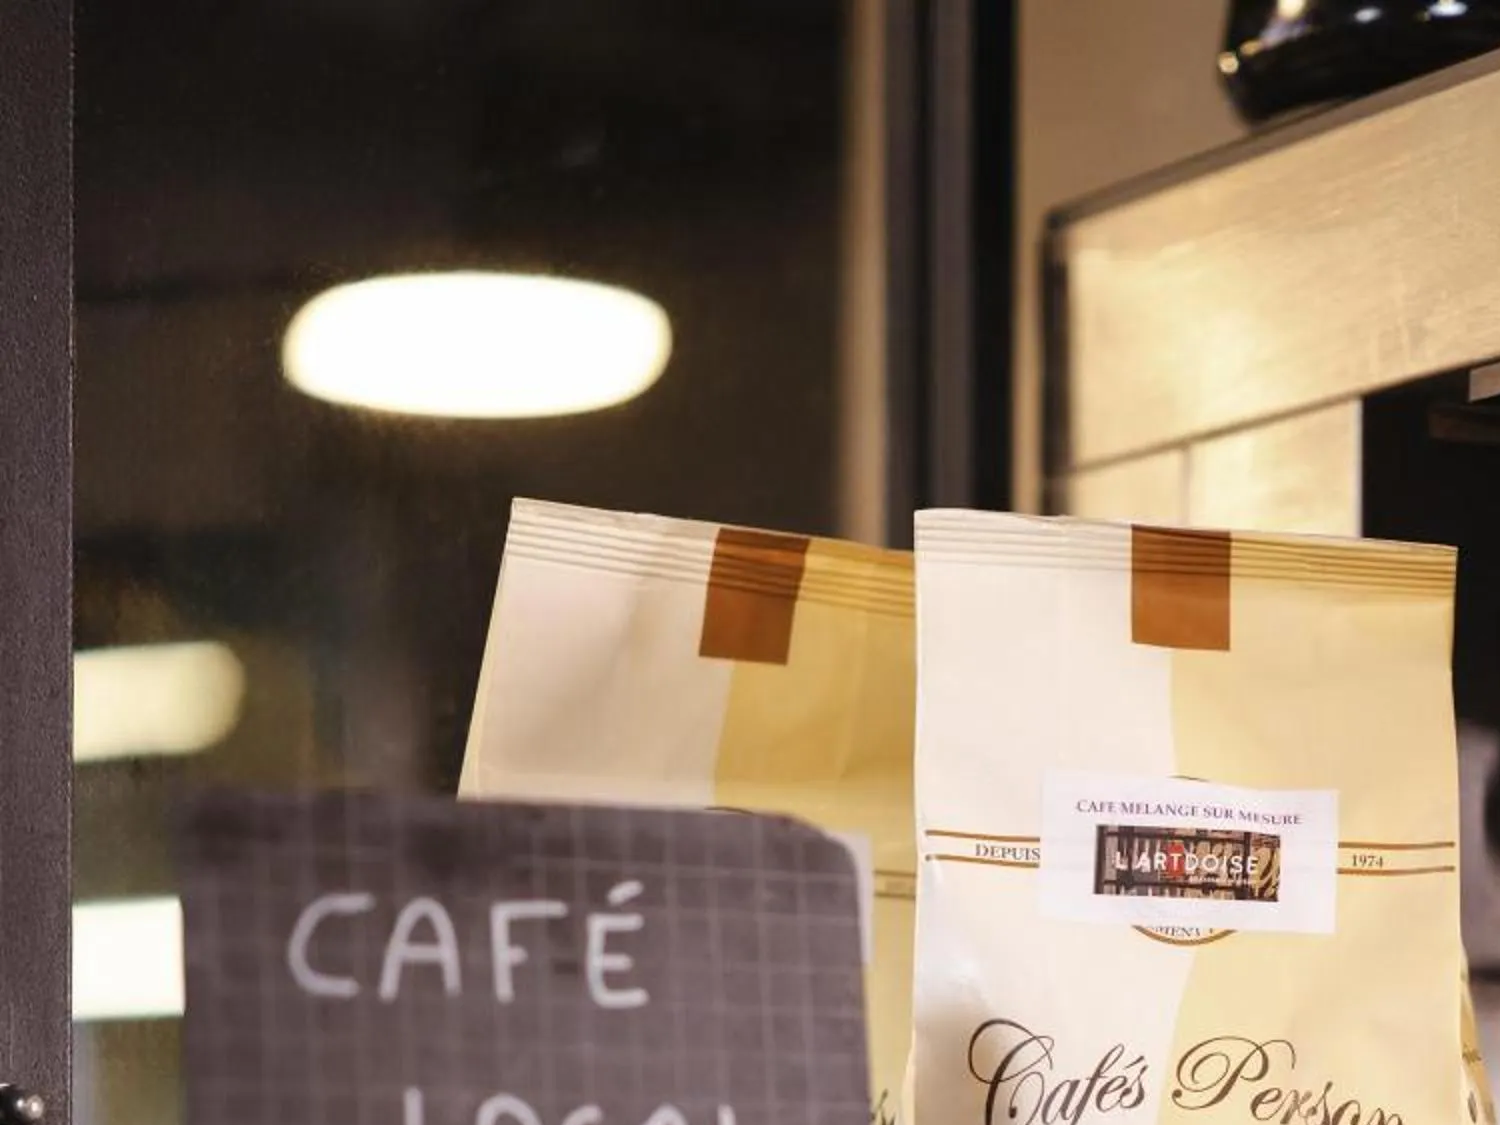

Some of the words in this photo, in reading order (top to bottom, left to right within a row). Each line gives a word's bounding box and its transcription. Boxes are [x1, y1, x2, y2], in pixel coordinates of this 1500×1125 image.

[1120, 801, 1199, 818] MELANGE
[1203, 806, 1234, 820] SUR
[1238, 809, 1304, 825] MESURE
[975, 842, 1041, 861] DEPUIS
[1352, 854, 1384, 869] 1974
[287, 878, 650, 1008] CAFÉ
